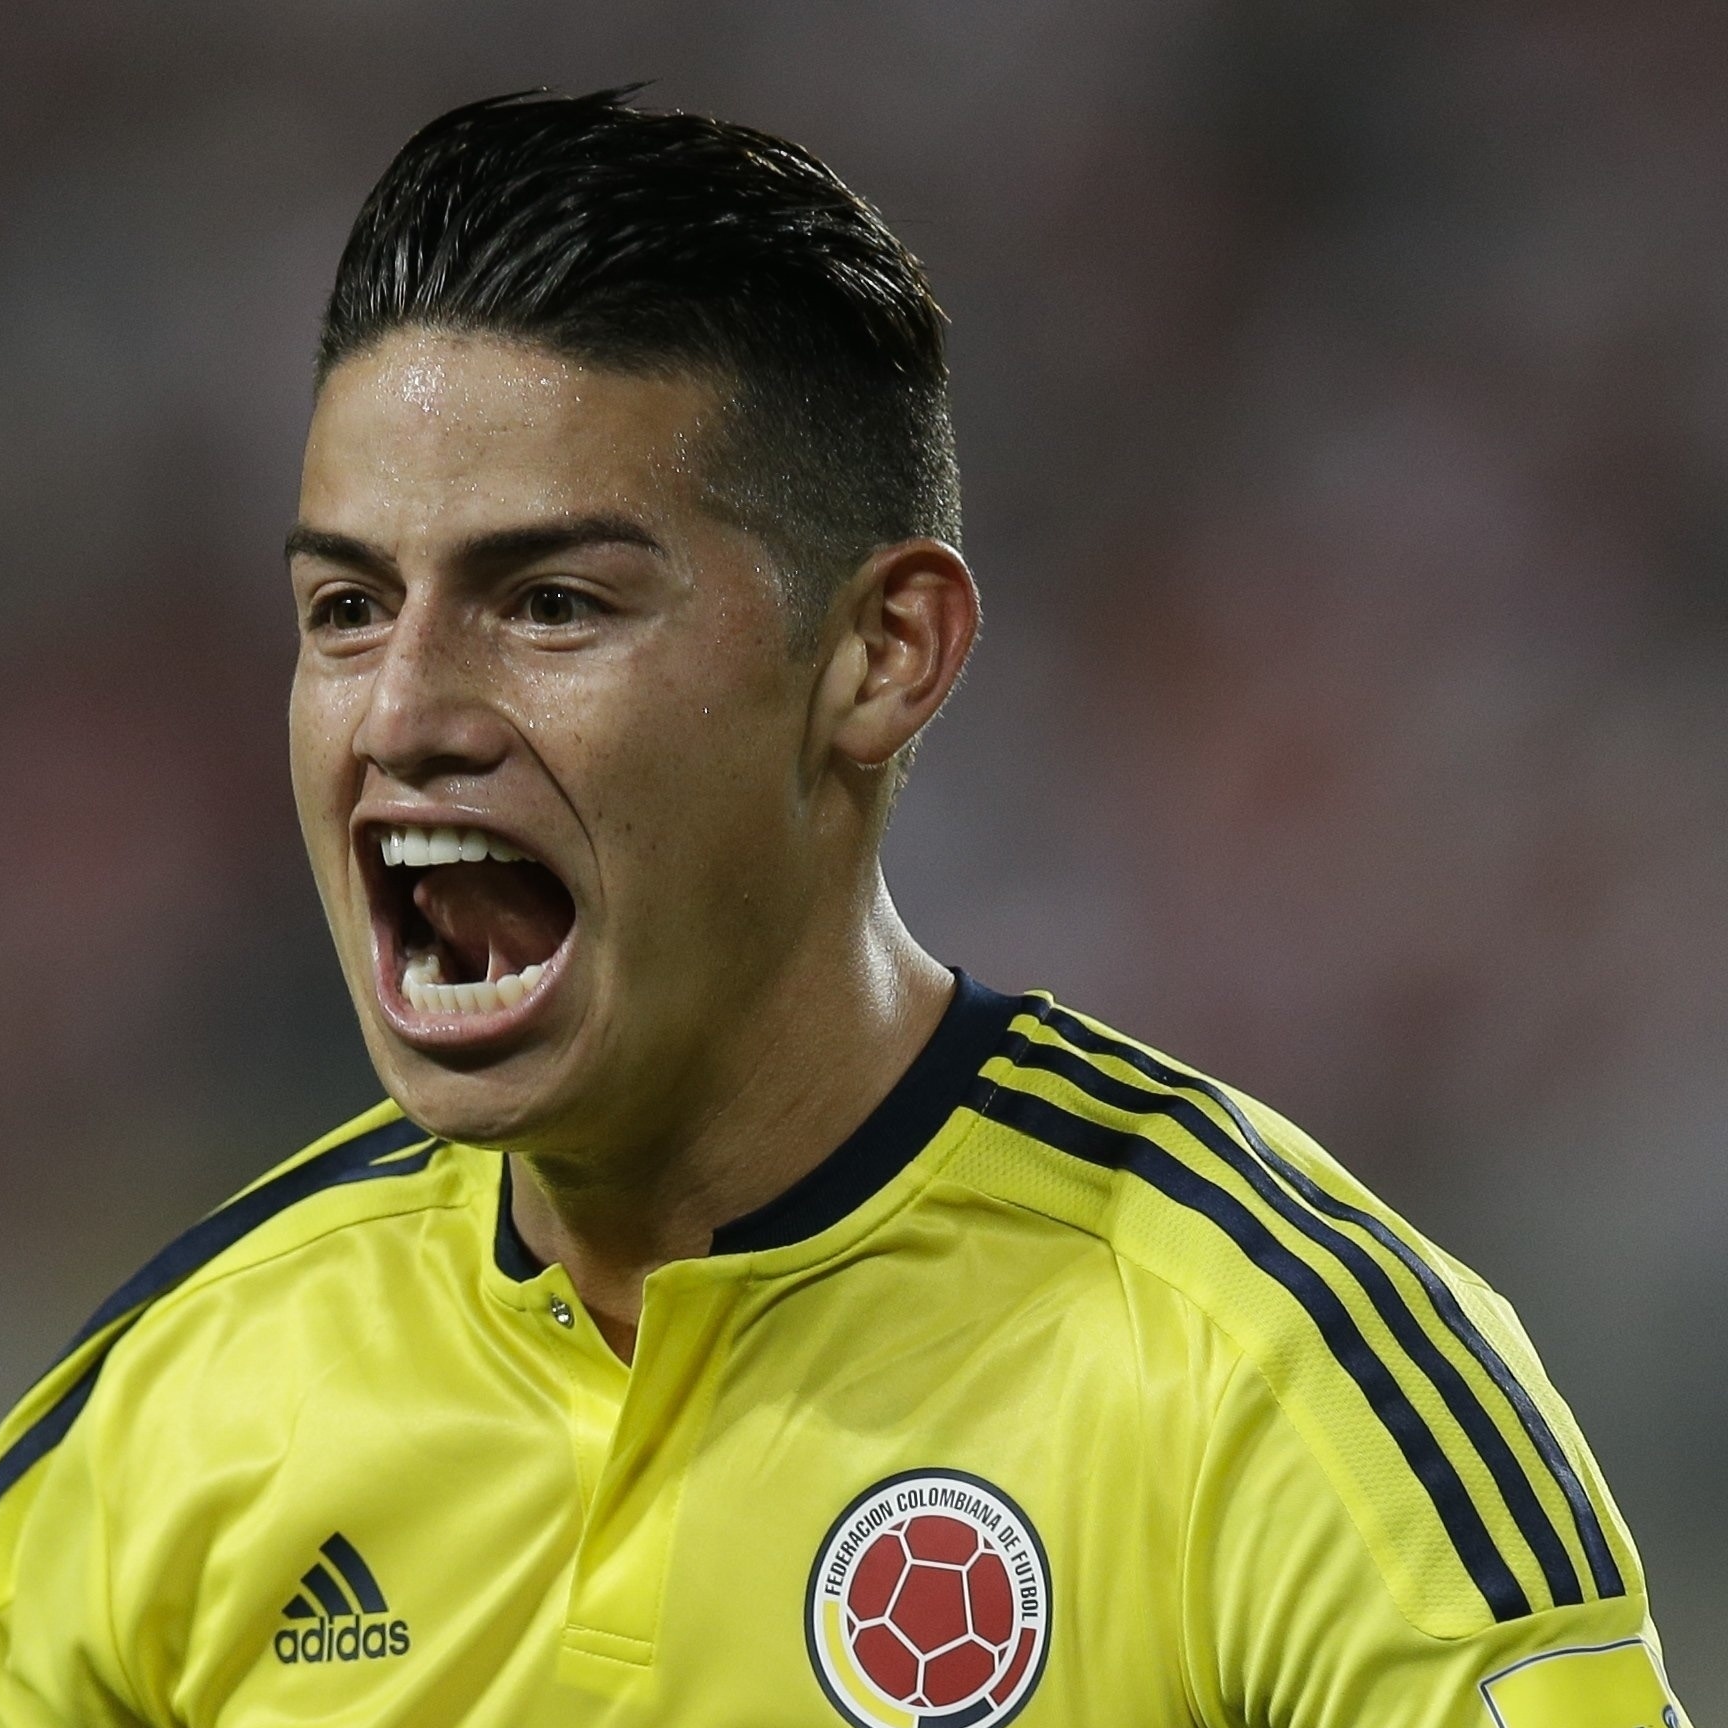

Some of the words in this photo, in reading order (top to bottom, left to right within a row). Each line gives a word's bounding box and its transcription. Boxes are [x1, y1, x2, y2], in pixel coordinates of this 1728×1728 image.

[825, 1500, 894, 1596] FEDERACION
[897, 1487, 1002, 1532] COLOMBIANA
[997, 1526, 1021, 1552] DE
[1011, 1551, 1039, 1621] FUTBOL
[274, 1615, 410, 1664] adidas
